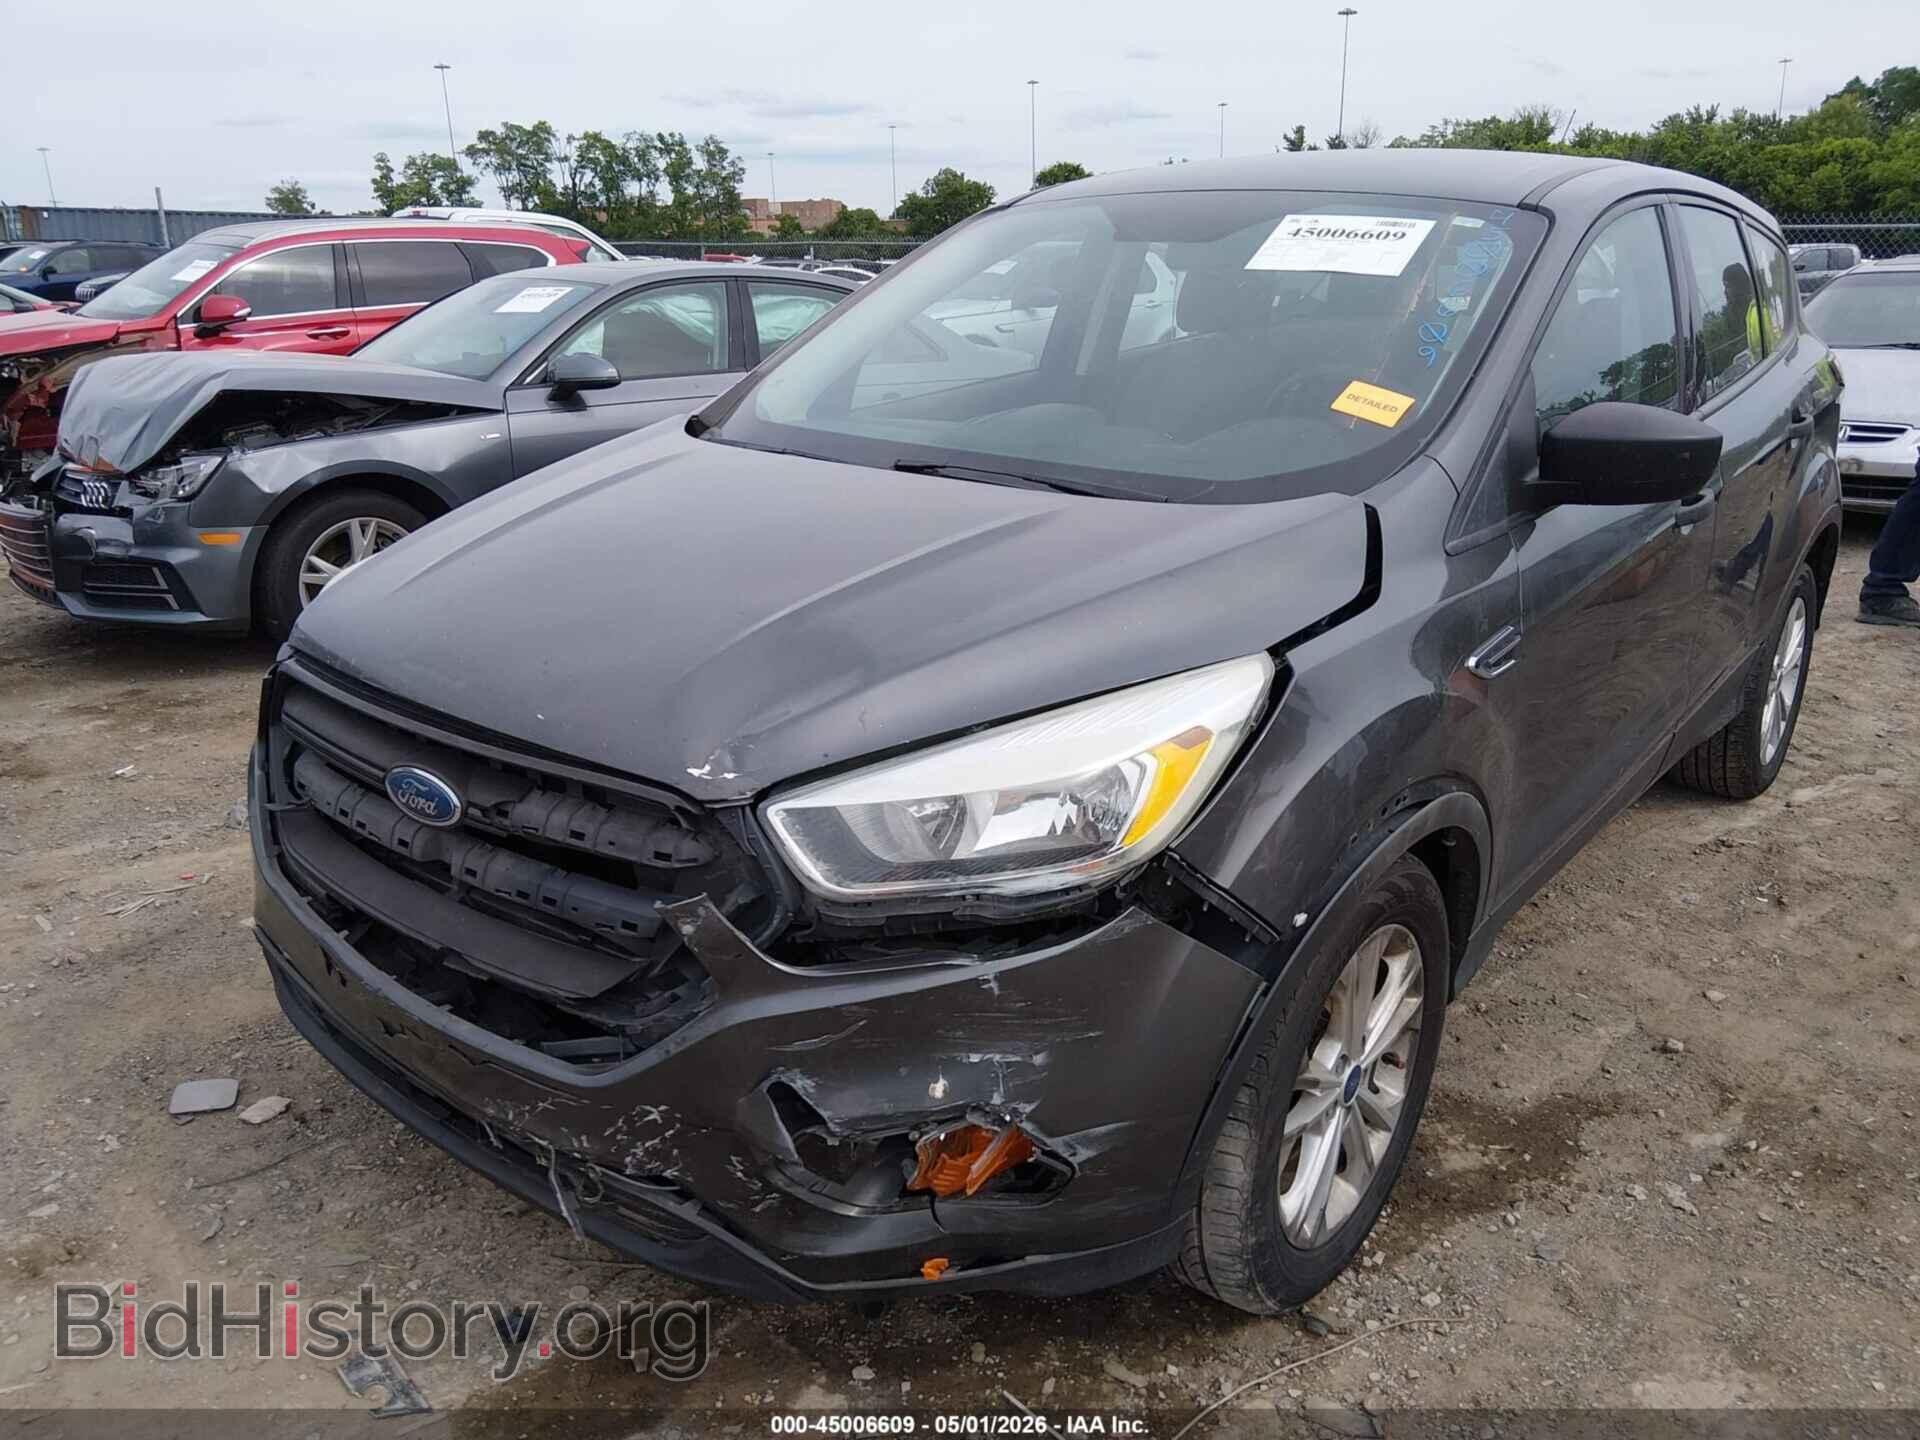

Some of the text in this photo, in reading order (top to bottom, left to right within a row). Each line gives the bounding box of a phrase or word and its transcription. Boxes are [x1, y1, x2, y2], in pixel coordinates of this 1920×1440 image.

[1287, 227, 1408, 241] 45006609
[1346, 393, 1398, 413] DETAILED
[398, 778, 439, 815] Ford
